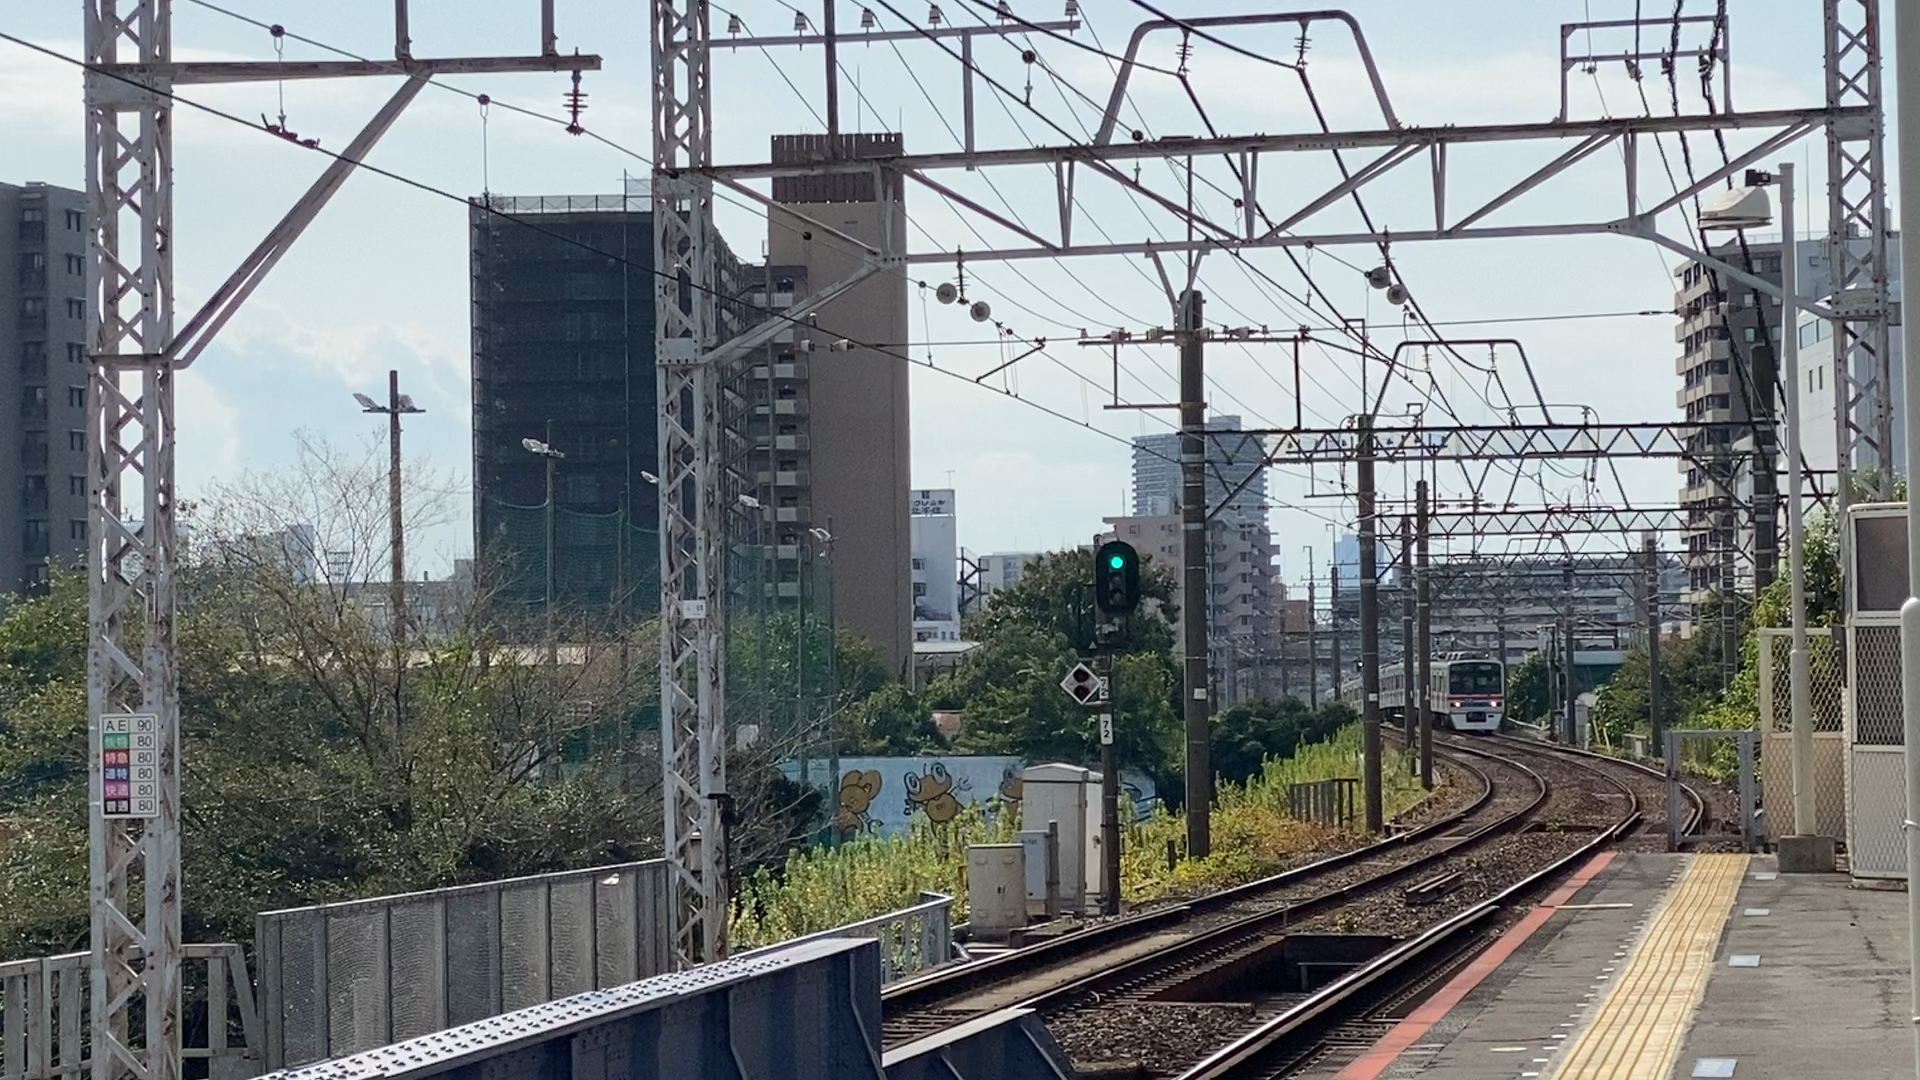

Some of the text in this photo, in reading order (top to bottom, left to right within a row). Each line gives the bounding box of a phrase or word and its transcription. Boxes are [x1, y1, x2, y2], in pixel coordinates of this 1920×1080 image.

[137, 720, 152, 732] 90
[1103, 720, 1110, 738] 72
[137, 736, 152, 747] 80
[105, 752, 152, 765] 特急 80
[138, 768, 152, 779] 80
[138, 784, 152, 796] 80
[138, 800, 153, 811] 80
